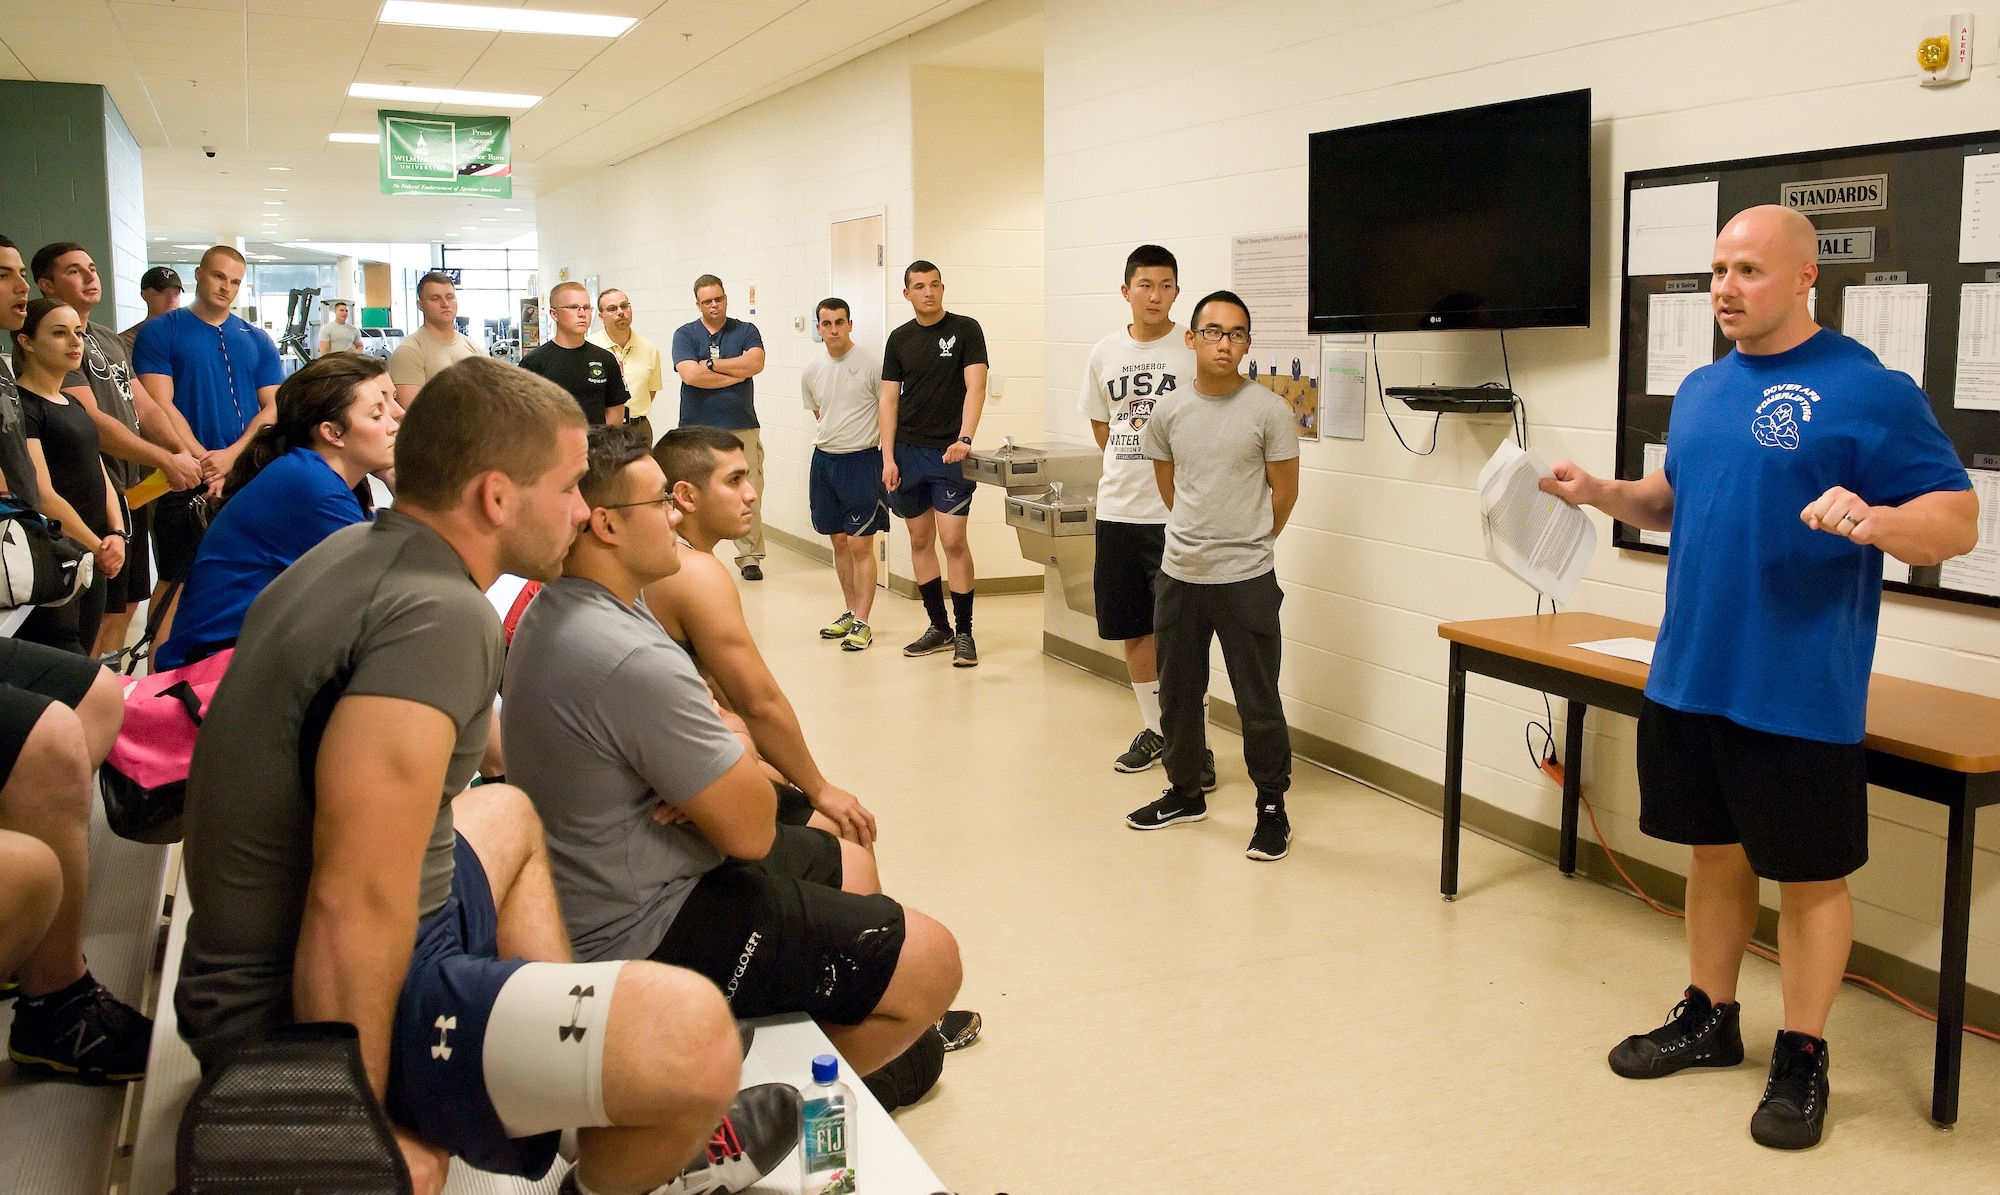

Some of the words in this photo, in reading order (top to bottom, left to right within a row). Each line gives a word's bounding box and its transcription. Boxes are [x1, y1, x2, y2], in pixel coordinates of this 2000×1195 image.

[394, 154, 450, 163] WILMINGTON
[488, 153, 505, 161] Runs
[1789, 184, 1878, 207] STANDARDS
[1818, 238, 1853, 255] ALE
[1889, 274, 1898, 282] 49
[1122, 363, 1156, 373] MEMBER
[1107, 372, 1177, 402] USA
[1763, 384, 1802, 398] DOVER
[1755, 392, 1812, 422] POWERLIFTING
[1117, 412, 1129, 420] 20
[816, 1124, 848, 1153] FIJI
